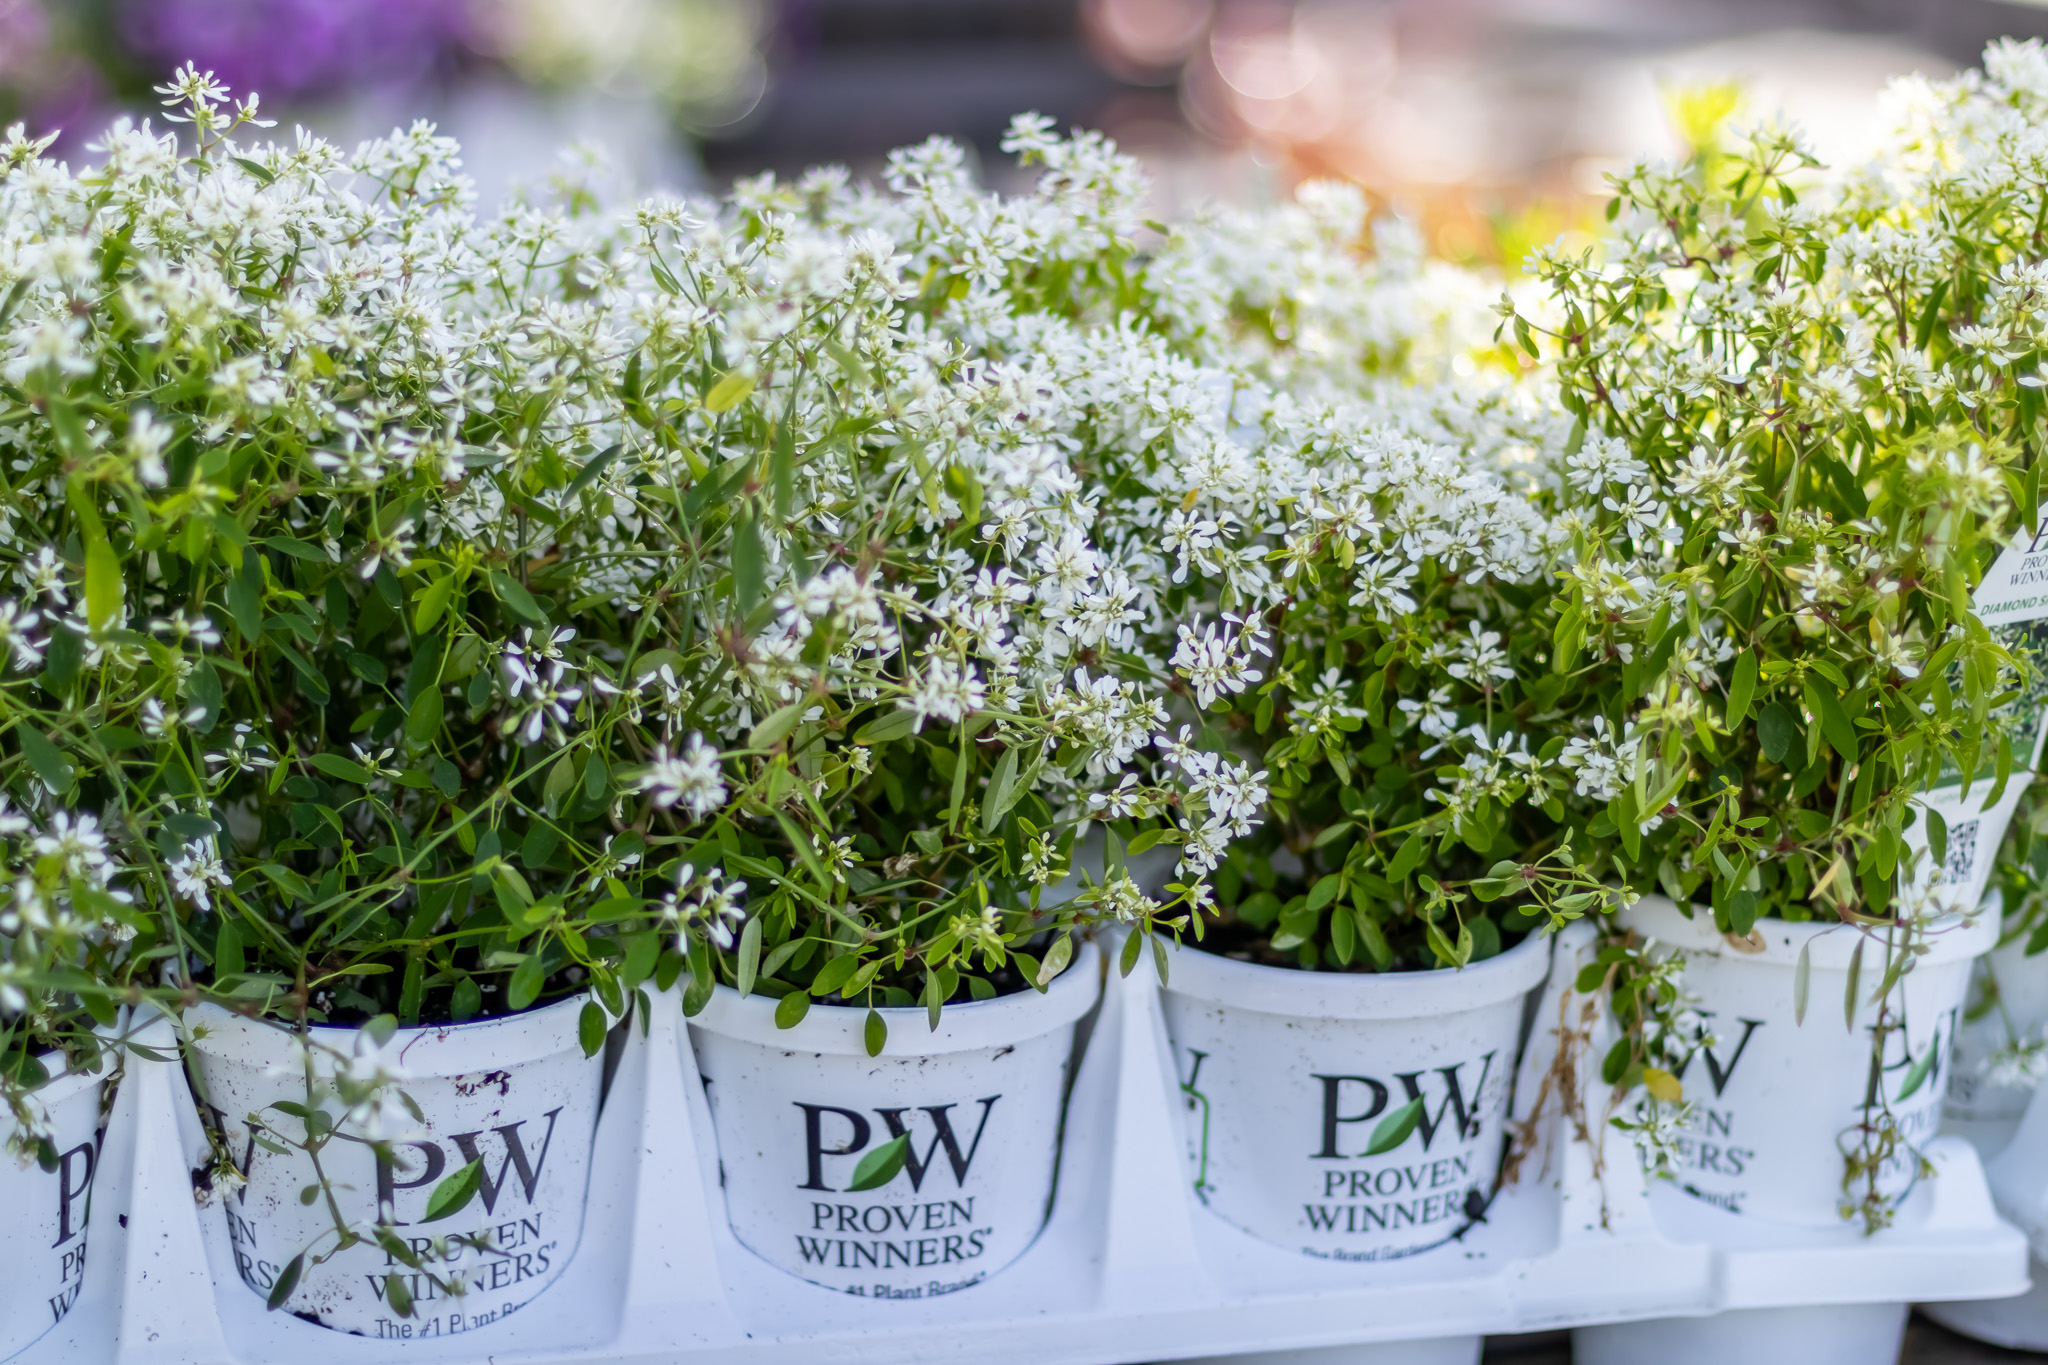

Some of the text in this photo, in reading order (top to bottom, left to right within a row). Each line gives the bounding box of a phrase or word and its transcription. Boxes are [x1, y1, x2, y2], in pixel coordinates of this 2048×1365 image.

[1980, 596, 2038, 616] DIAMOND
[1668, 1007, 1766, 1098] W
[1308, 1048, 1498, 1159] PW
[374, 1107, 564, 1227] PW
[792, 1094, 1002, 1193] PW
[1324, 1151, 1472, 1197] PROVEN
[52, 1130, 103, 1249] P
[811, 1197, 975, 1232] PROVEN
[1303, 1189, 1465, 1232] WINNER
[375, 1319, 412, 1339] The
[419, 1317, 440, 1338] #1
[450, 1310, 498, 1335] Plant
